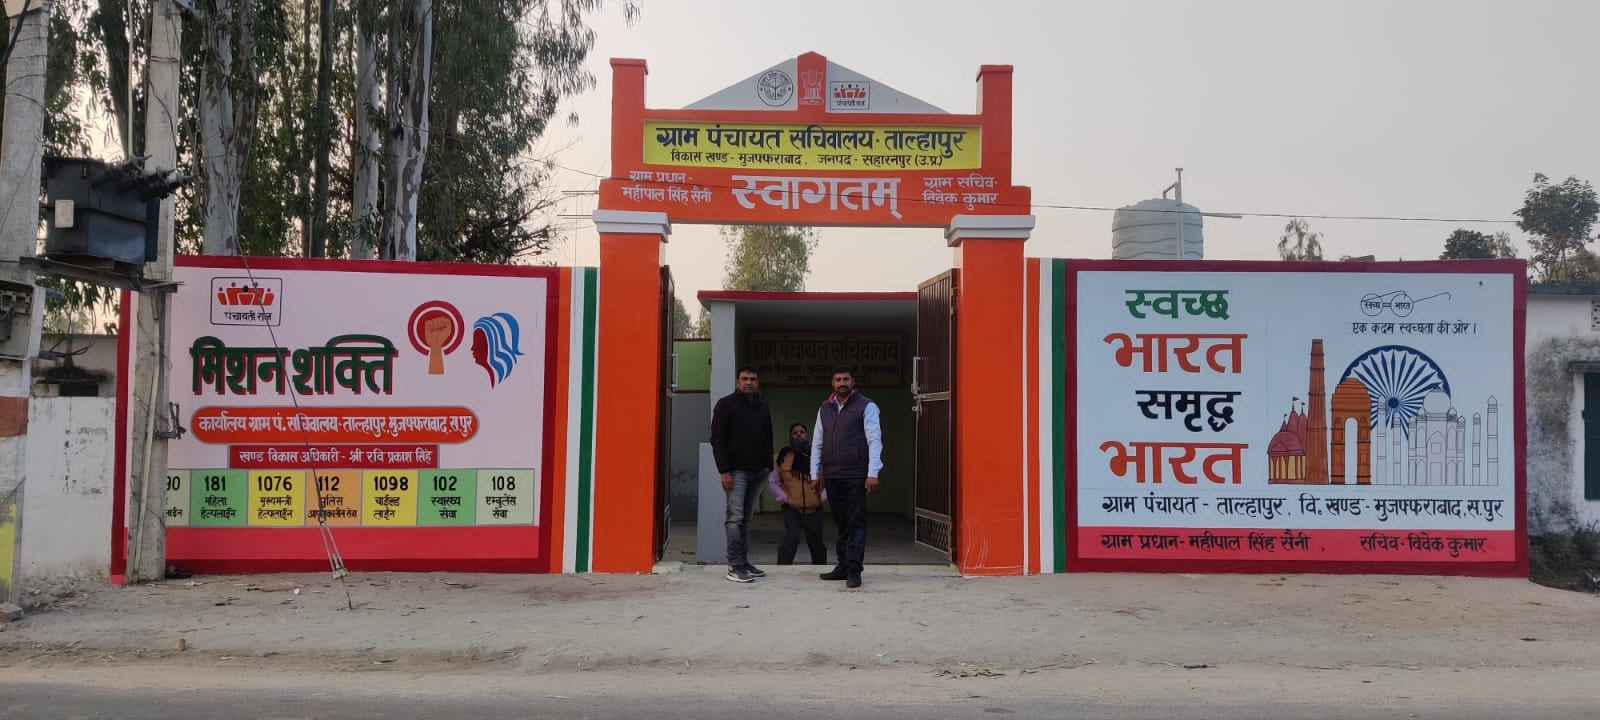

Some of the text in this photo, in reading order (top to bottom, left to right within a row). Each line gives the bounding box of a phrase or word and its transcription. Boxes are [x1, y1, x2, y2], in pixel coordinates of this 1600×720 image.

[656, 127, 700, 148] ग्राम
[706, 124, 784, 149] पंचायत
[884, 130, 967, 158] ताल्हापुर
[671, 149, 701, 162] विकास
[705, 152, 728, 163] खण्ड
[818, 154, 852, 166] जनपद
[862, 154, 911, 168] सहारनपुर
[630, 170, 653, 182] ग्राम
[656, 172, 686, 184] प्रधान
[923, 177, 953, 189] ग्राम
[622, 183, 712, 205] महीपाल सिंह सैनी
[731, 174, 903, 220] स्वागतम्
[922, 189, 998, 211] विवेक कुमार
[1125, 290, 1230, 320] स्वच्छ
[1352, 322, 1367, 335] एक
[1371, 322, 1394, 334] कदम
[1398, 322, 1434, 334] स्वच्छता
[1436, 319, 1450, 334] की
[1452, 319, 1471, 334] ओर
[1103, 333, 1248, 373] भारत
[189, 334, 399, 395] मिशन शक्ति
[1135, 390, 1242, 432] समृद्ध
[198, 411, 247, 432] कार्यालय
[248, 416, 271, 431] ग्राम
[239, 451, 264, 462] खण्ड
[268, 447, 298, 462] विकास
[300, 448, 339, 462] अधिकारी
[349, 448, 363, 463] श्री
[366, 449, 384, 462] रवि
[387, 451, 412, 463] प्रकाश
[415, 447, 432, 464] सिंह
[1099, 441, 1249, 484] भारत
[204, 476, 226, 491] 181
[258, 476, 293, 491] 1076
[318, 476, 340, 491] 112
[374, 476, 409, 491] 1098
[433, 476, 457, 491] 102
[492, 476, 516, 491] 108
[439, 507, 457, 519] सेवा
[492, 507, 508, 519] सेवा
[1101, 496, 1137, 513] ग्राम
[1143, 492, 1199, 514] पंचायत
[1325, 498, 1365, 515] खण्ड
[1101, 534, 1134, 549] ग्राम
[1188, 531, 1241, 551] महीपाल
[1248, 532, 1275, 552] सिंह
[1280, 529, 1311, 551] सैनी
[1407, 530, 1444, 552] विवेक
[1447, 535, 1486, 557] कुमार
